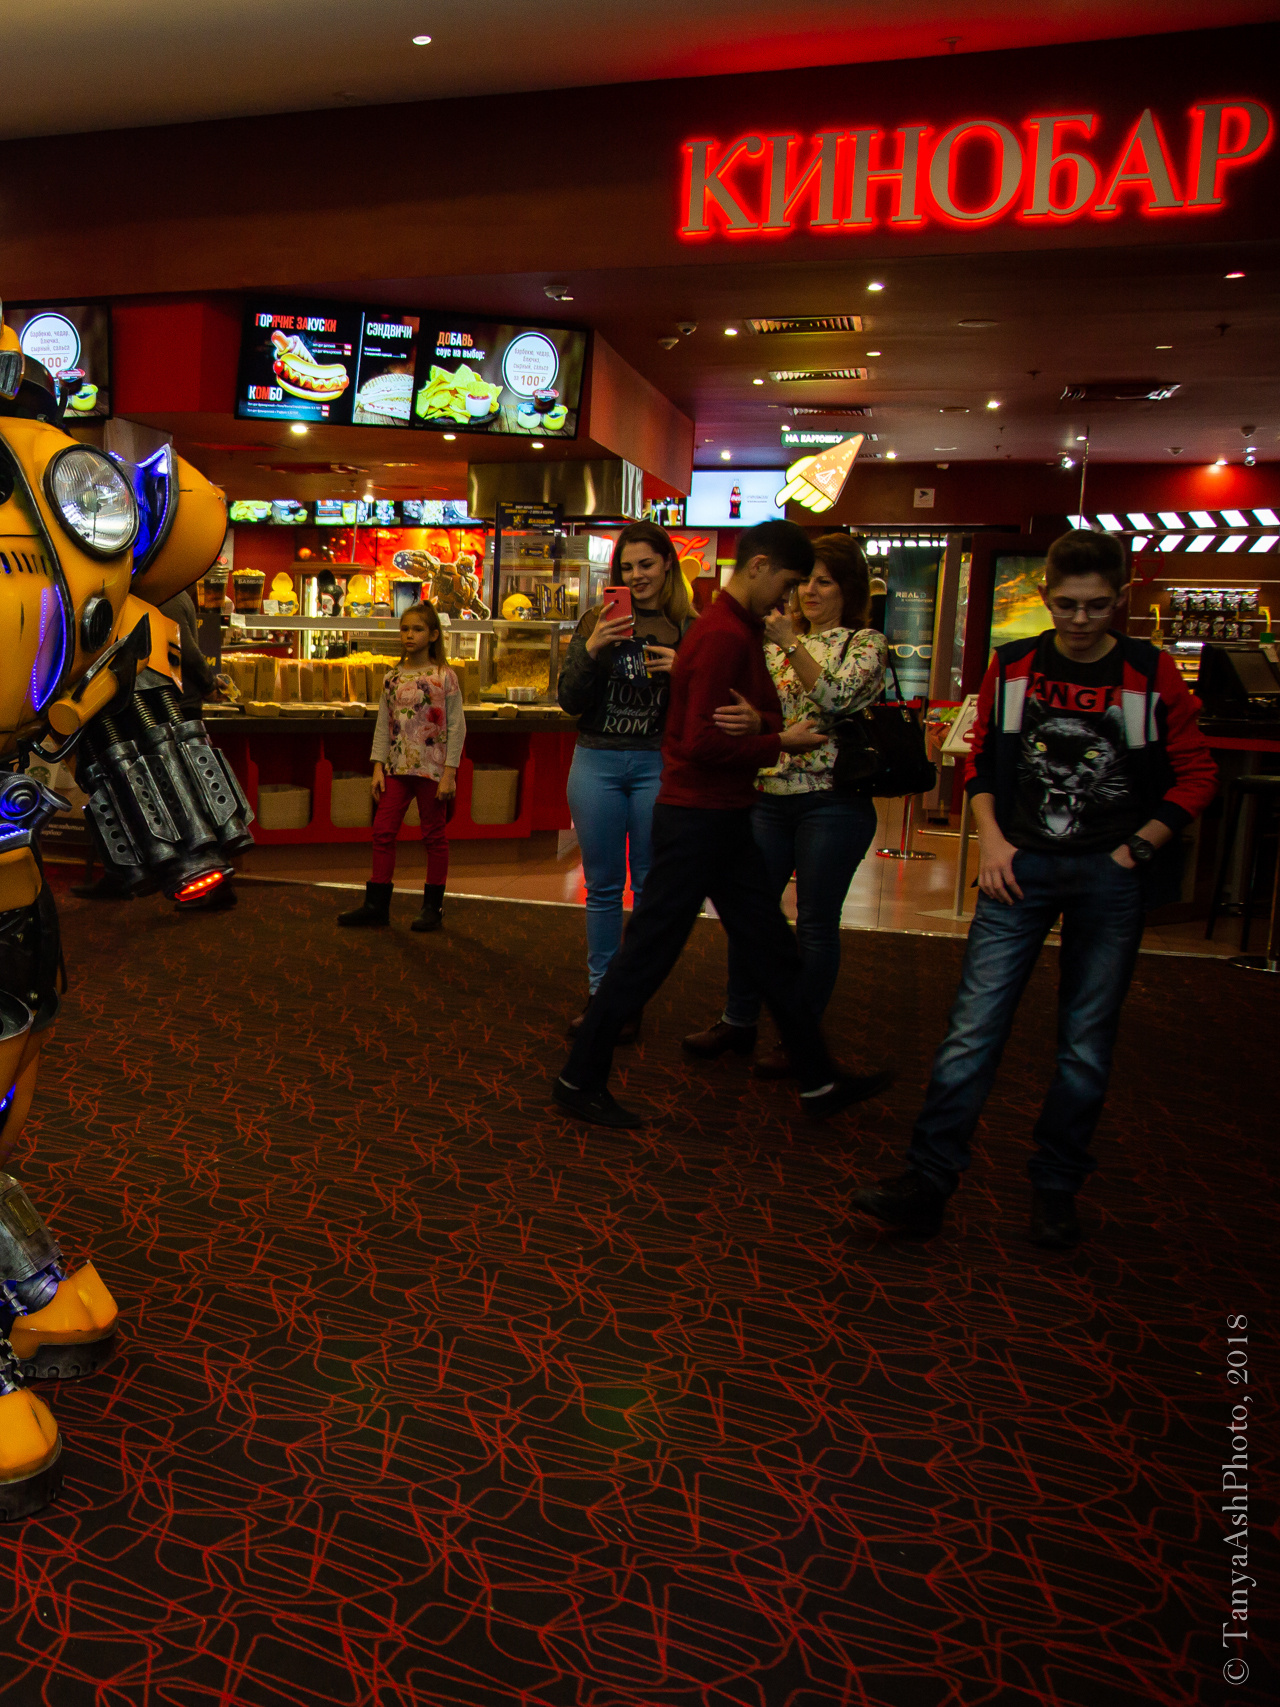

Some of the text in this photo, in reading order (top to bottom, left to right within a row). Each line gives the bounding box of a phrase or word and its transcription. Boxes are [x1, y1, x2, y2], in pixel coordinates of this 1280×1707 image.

[680, 100, 1271, 233] КИНОБАР
[255, 313, 337, 333] ГОРЯЧИЕ ЗАКУСКИ
[366, 322, 412, 339] СЭНДВИЧИ
[437, 331, 473, 347] ДОБАВЬ
[41, 357, 61, 368] 100
[521, 375, 540, 386] 100
[248, 385, 283, 401] КОМБО
[785, 434, 799, 443] НА
[602, 715, 658, 735] ROM
